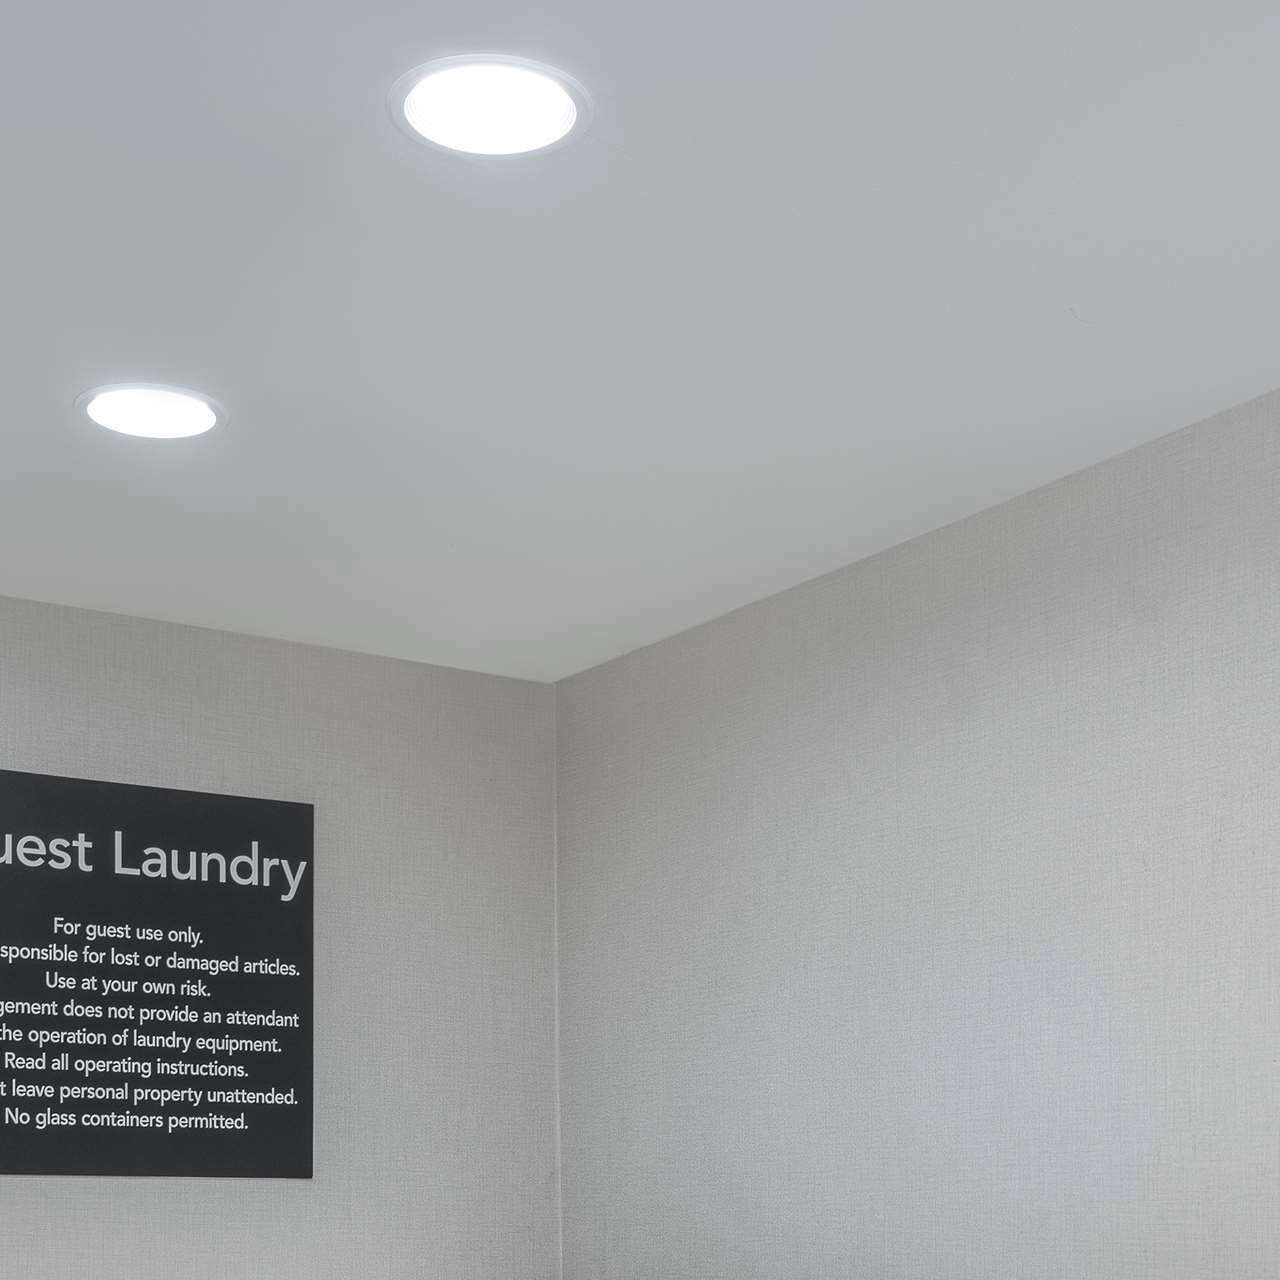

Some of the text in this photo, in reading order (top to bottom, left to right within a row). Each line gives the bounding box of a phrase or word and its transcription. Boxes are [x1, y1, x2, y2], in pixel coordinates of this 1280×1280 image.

[115, 830, 307, 902] Laundry
[54, 917, 203, 948] For guest use only.
[82, 945, 106, 964] for
[111, 947, 140, 966] lost
[144, 955, 162, 967] or
[166, 951, 239, 976] damaged
[243, 958, 300, 976] articles.
[46, 971, 211, 997] Use at your own risk.
[63, 999, 103, 1018] does
[108, 1005, 135, 1020] not
[140, 1005, 199, 1026] provide
[203, 1011, 221, 1024] an
[226, 1009, 299, 1028] attendant
[28, 1028, 107, 1048] operation
[112, 1028, 129, 1046] of
[133, 1029, 192, 1053] laundry
[196, 1034, 282, 1056] equipment.
[5, 1051, 248, 1078] Read all operating instructions.
[12, 1078, 55, 1098] leave
[60, 1082, 128, 1104] personal
[134, 1087, 203, 1107] property
[207, 1087, 298, 1105] unattended.
[5, 1107, 248, 1133] No glass containers permitted.
